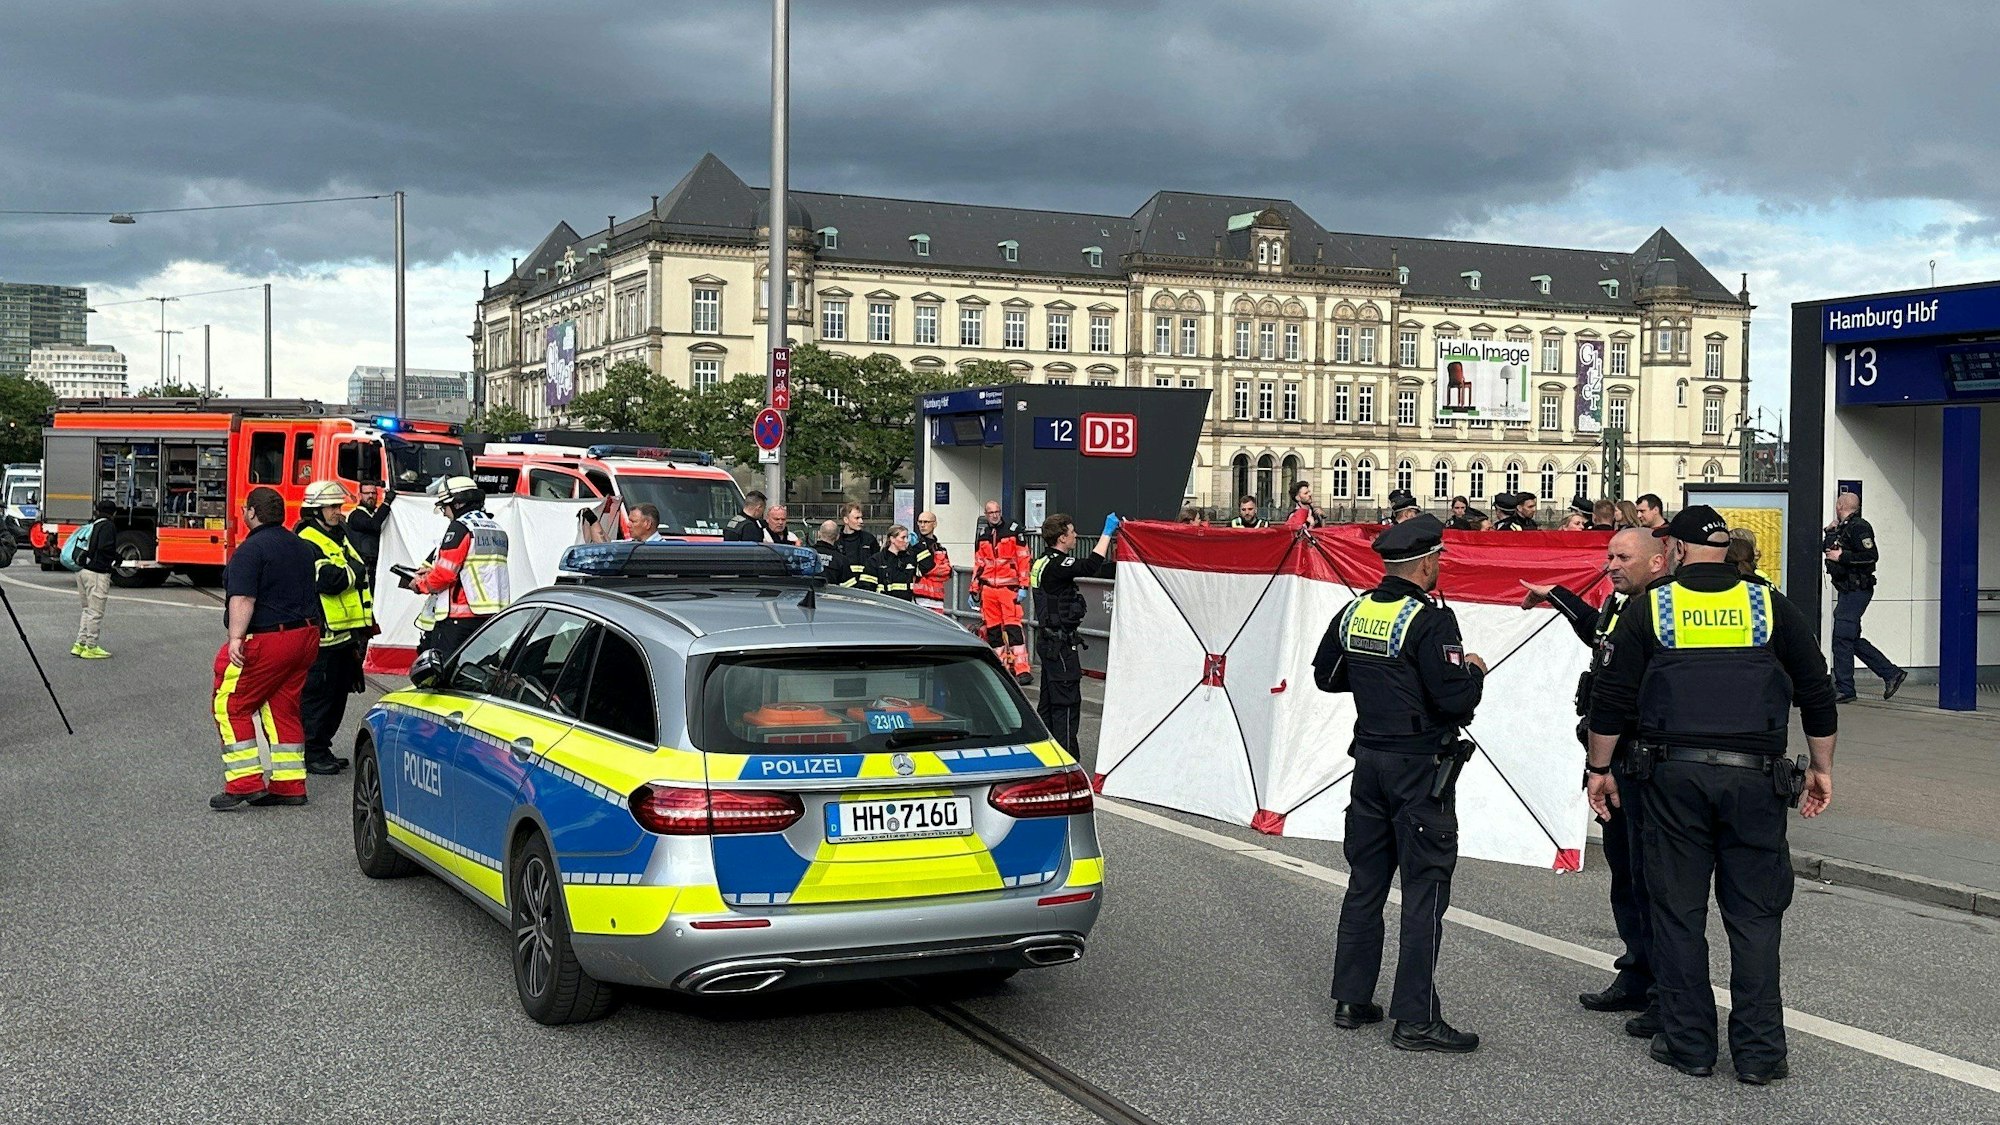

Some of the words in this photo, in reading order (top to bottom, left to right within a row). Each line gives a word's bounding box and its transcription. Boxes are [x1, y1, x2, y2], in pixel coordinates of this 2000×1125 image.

[1829, 306, 1903, 331] Hamburg
[1907, 299, 1939, 323] Hbf
[775, 352, 787, 360] 01
[1439, 341, 1479, 359] Hello
[1482, 344, 1530, 366] Image
[775, 369, 787, 377] 07
[1579, 342, 1604, 411] Glitzer
[1844, 346, 1878, 387] 13
[1050, 419, 1073, 442] 12
[1089, 420, 1130, 450] DB
[444, 456, 452, 467] 6
[1351, 616, 1391, 637] POLIZEI
[1682, 609, 1744, 627] POLIZEI
[873, 713, 905, 731] 23/10
[403, 750, 442, 798] POLIZEI
[761, 757, 843, 776] POLIZEI
[852, 805, 885, 832] HH
[900, 801, 958, 829] 7160
[830, 824, 838, 833] D
